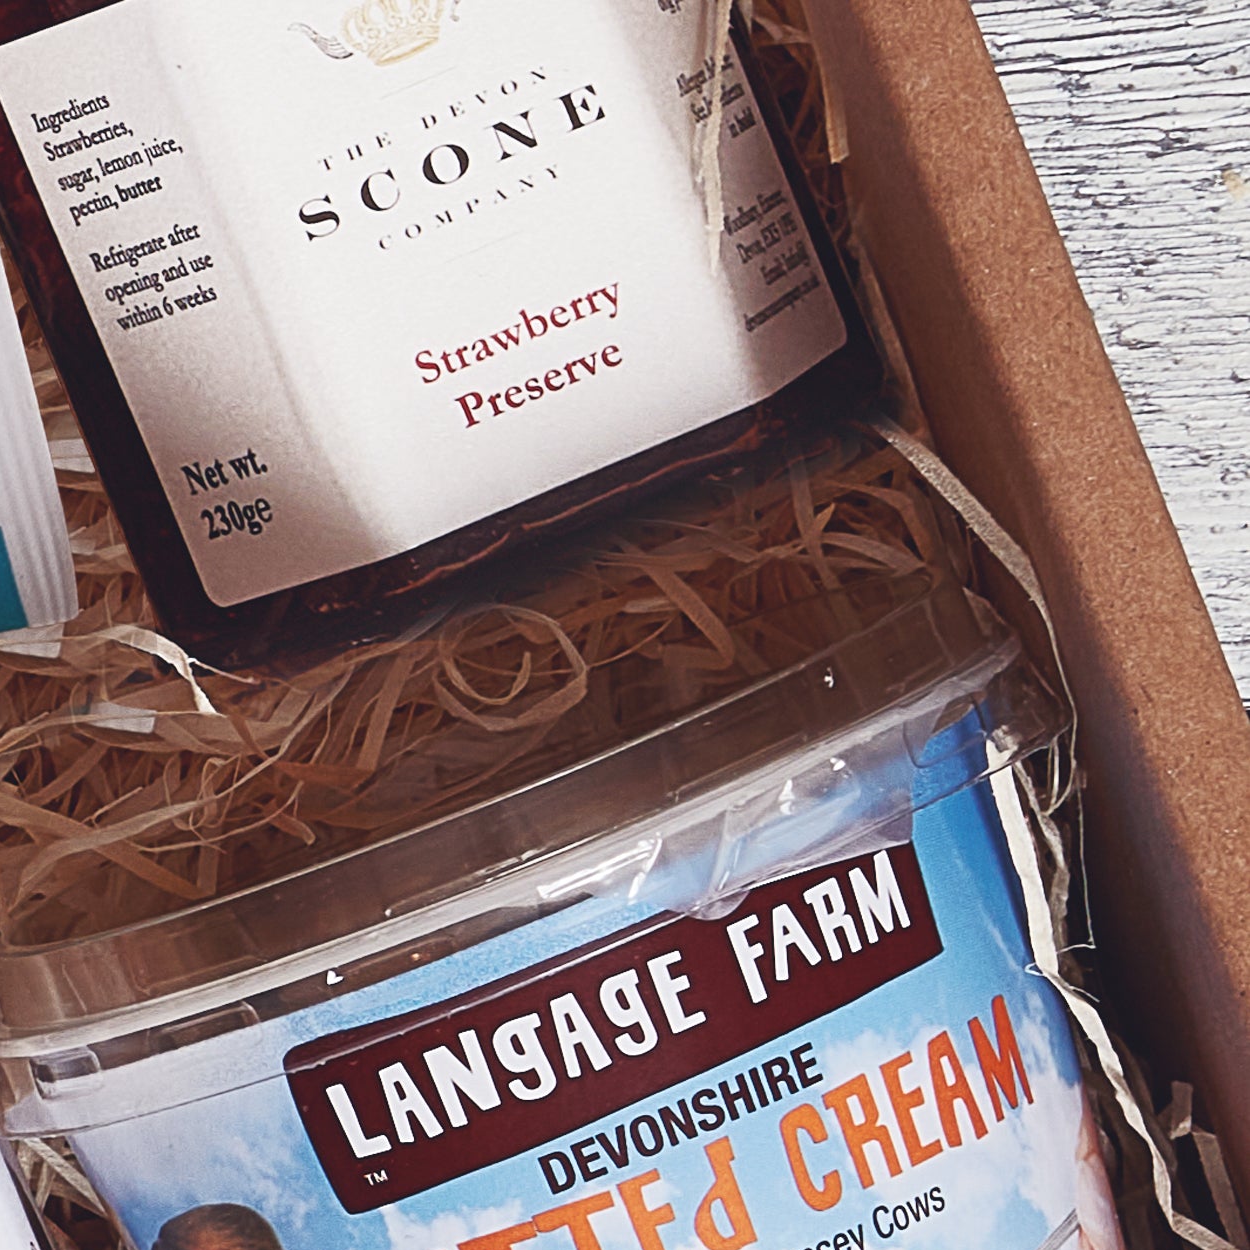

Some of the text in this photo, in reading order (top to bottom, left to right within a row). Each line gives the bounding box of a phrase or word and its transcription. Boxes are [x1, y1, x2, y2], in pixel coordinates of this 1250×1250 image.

[31, 94, 110, 133] Ingredients
[43, 118, 133, 162] Strawberries,
[318, 66, 549, 172] THE DEVON
[57, 133, 184, 193] sugar, lemon juice,
[298, 84, 606, 242] SCONE
[69, 175, 163, 226] pectin, butter
[378, 163, 561, 251] COMPANY
[89, 222, 201, 272] Refrigerate after
[104, 253, 214, 304] opening and use
[117, 284, 218, 331] within 6 weeks
[414, 282, 620, 385] Strawberry
[454, 343, 623, 429] Preserve
[181, 447, 268, 496] Net wt.
[726, 850, 912, 1003] FARM
[537, 1043, 824, 1195] DEVONSHIRE
[779, 995, 1034, 1211] CREAM
[872, 1186, 946, 1240] Cows
